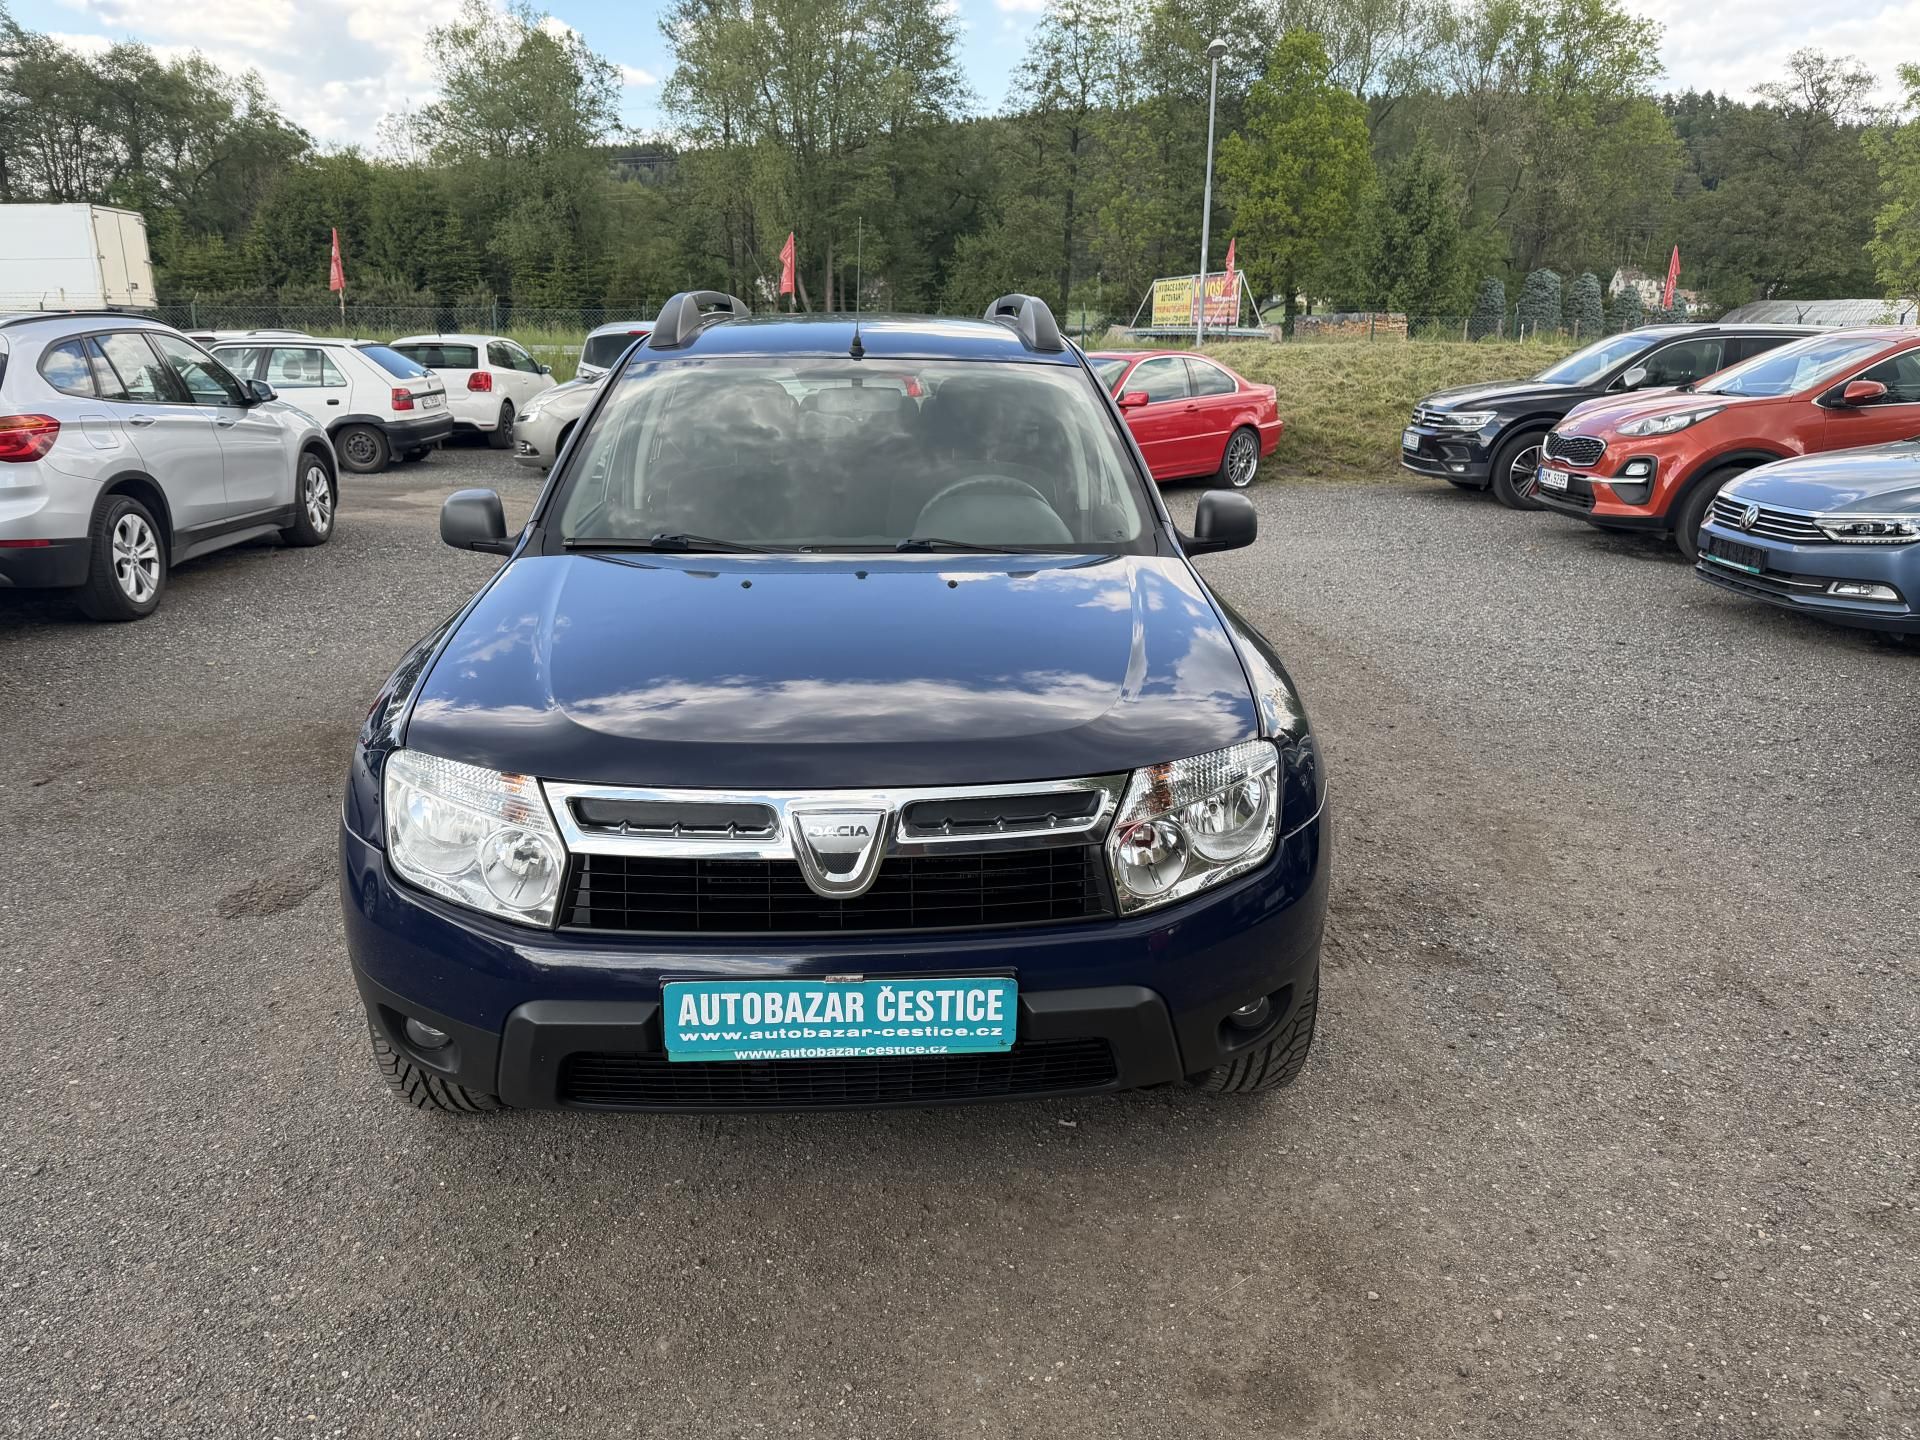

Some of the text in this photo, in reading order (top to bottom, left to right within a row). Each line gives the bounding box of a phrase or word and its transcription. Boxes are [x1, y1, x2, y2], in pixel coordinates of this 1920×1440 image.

[807, 825, 870, 837] DACIA
[678, 986, 1004, 1026] AUTOBAZAR ČESTICE
[679, 1026, 1003, 1042] www.autobazar-cestice.cz
[734, 1045, 948, 1060] www.autobazar-cestice.cz
